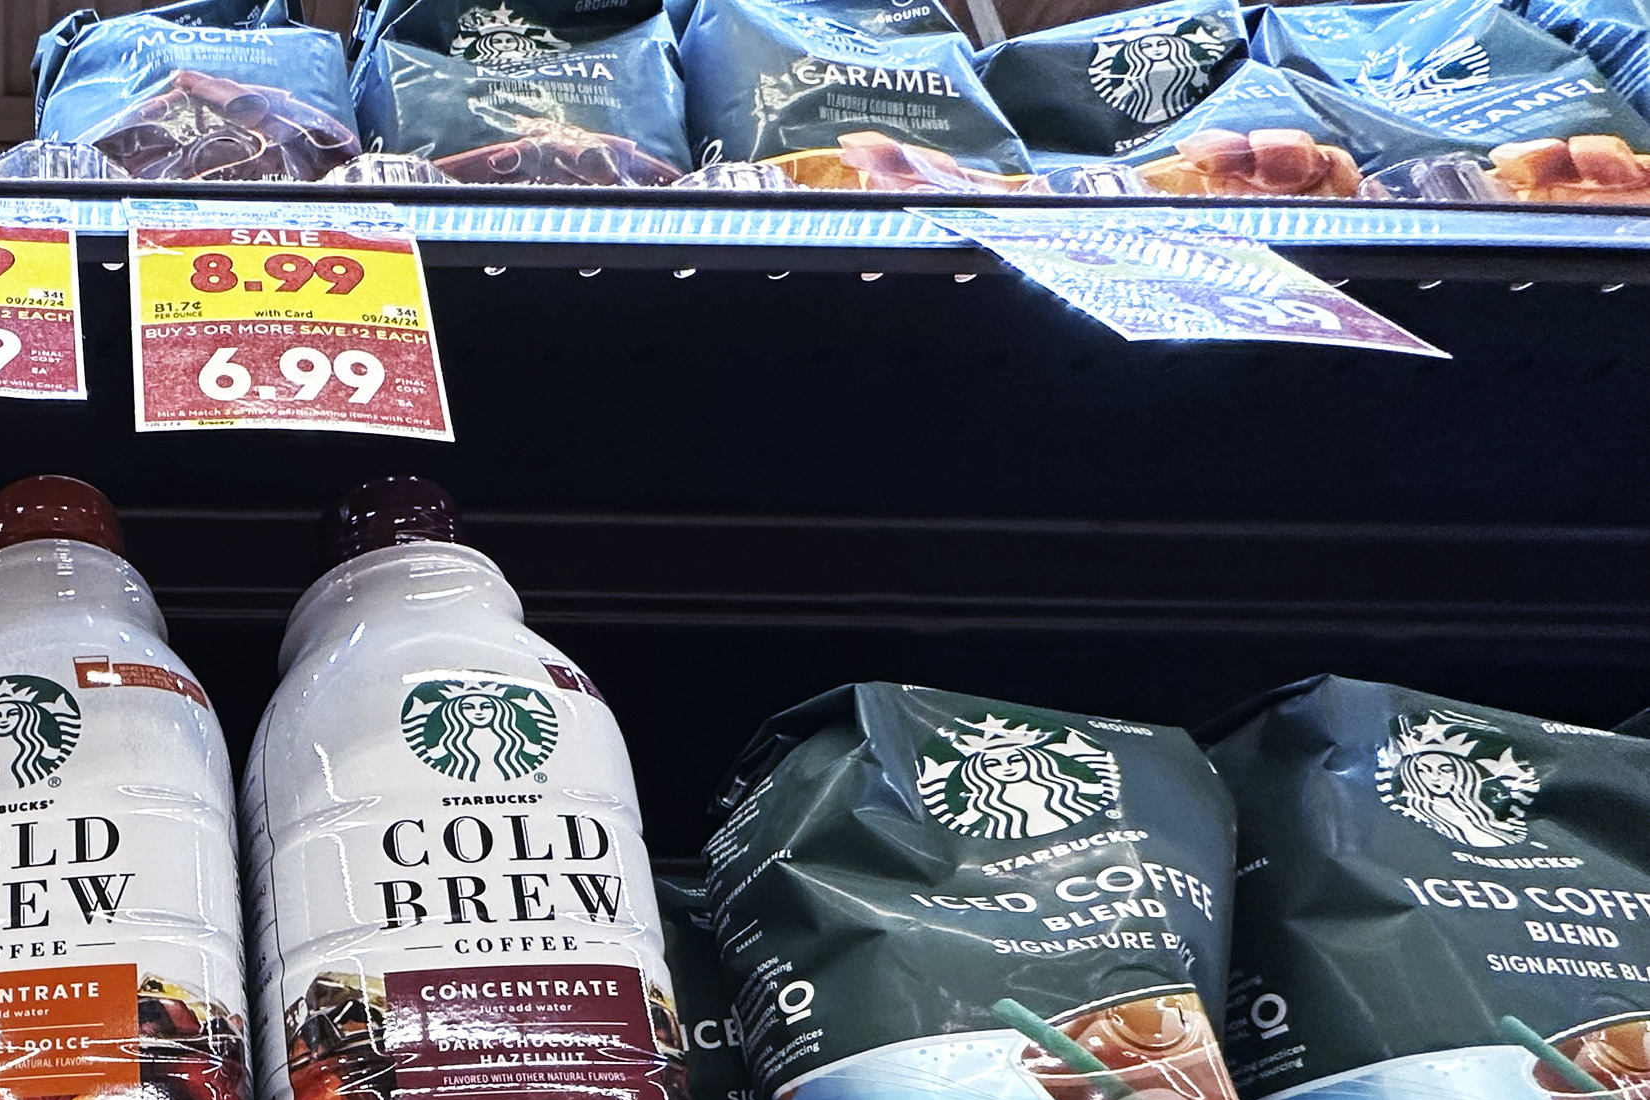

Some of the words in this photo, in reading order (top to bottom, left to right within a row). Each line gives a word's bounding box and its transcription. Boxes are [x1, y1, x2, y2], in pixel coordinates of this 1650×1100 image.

[875, 6, 930, 24] GROUND
[135, 28, 274, 51] MOCHA
[476, 62, 614, 80] MOCHA
[797, 65, 960, 98] CARAMEL
[231, 230, 321, 247] SALE
[190, 253, 365, 295] 8.99
[5, 296, 64, 308] 09/24/24
[154, 301, 202, 312] 81.7¢
[254, 309, 281, 318] with
[285, 310, 313, 319] Card
[361, 313, 419, 327] 09/24/24
[145, 326, 183, 338] BUY
[186, 326, 197, 335] 3
[203, 324, 232, 336] OR
[238, 324, 294, 335] MORE
[300, 325, 346, 336] SAVE
[377, 330, 428, 344] EACH
[198, 347, 386, 405] 6.99
[381, 814, 611, 868] COLD
[373, 872, 623, 931] BREW
[910, 891, 1038, 913] ICED
[1054, 862, 1213, 922] COFFEE
[1404, 877, 1519, 911] ICED
[1525, 887, 1650, 921] COFF
[1041, 898, 1166, 932] BLEND
[992, 932, 1156, 954] SIGNATURE
[1525, 920, 1619, 948] BLEND
[454, 935, 578, 955] COFFEE
[420, 980, 619, 1001] CONCENTRATE
[443, 1074, 489, 1085] FLAVORED
[490, 1073, 513, 1083] WITH
[515, 1073, 545, 1082] OTHER
[547, 1072, 586, 1081] NATURAL
[588, 1072, 626, 1082] FLAVORS
